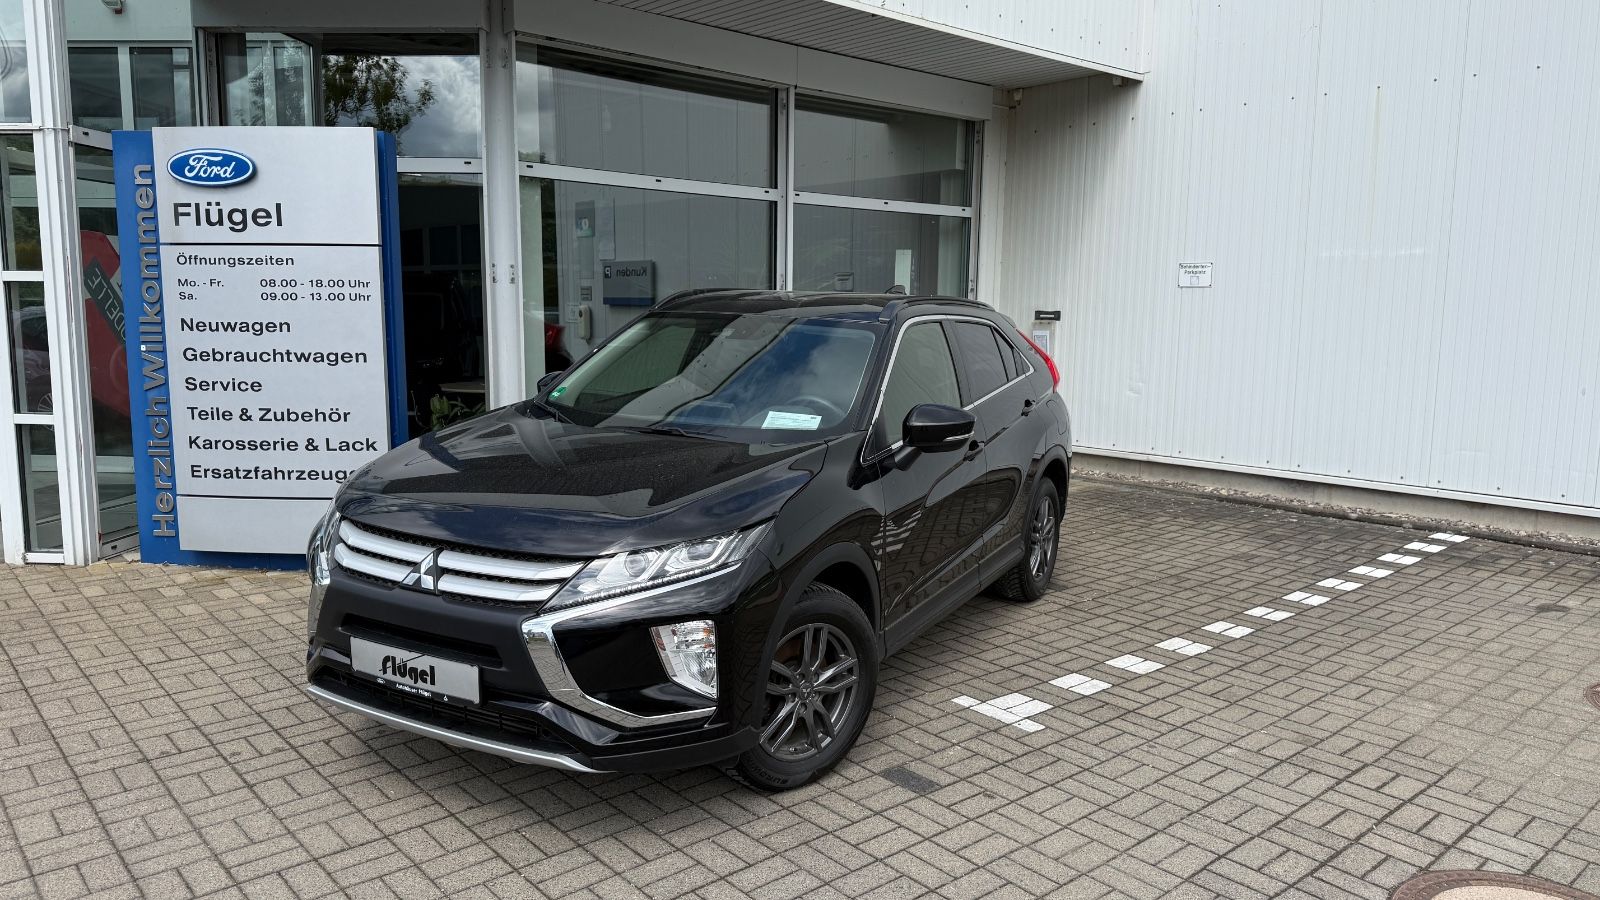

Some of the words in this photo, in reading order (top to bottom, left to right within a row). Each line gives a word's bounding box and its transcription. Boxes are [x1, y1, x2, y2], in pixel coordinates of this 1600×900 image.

[184, 154, 236, 178] Ford
[172, 202, 283, 232] Flügel
[176, 252, 295, 267] Öffnungszeiten
[133, 164, 166, 391] Willkommen
[177, 278, 200, 288] Mo.
[209, 278, 225, 288] Fr.
[259, 278, 298, 289] 08.00
[308, 278, 345, 289] 18.00
[348, 278, 371, 289] Uhr
[178, 291, 199, 301] Sa.
[260, 291, 299, 302] 09.00
[348, 291, 372, 302] Uhr
[180, 317, 291, 336] Neuwagen
[182, 347, 368, 367] Gebrauchtwagen
[184, 376, 263, 393] Service
[186, 406, 234, 422] Teile
[238, 407, 254, 422] &
[258, 407, 351, 423] Zubehör
[188, 435, 299, 452] Karosserie
[304, 437, 321, 452] &
[325, 437, 379, 452] Lack
[145, 396, 176, 538] Herzlich
[190, 464, 355, 484] Ersatzfahrzeug
